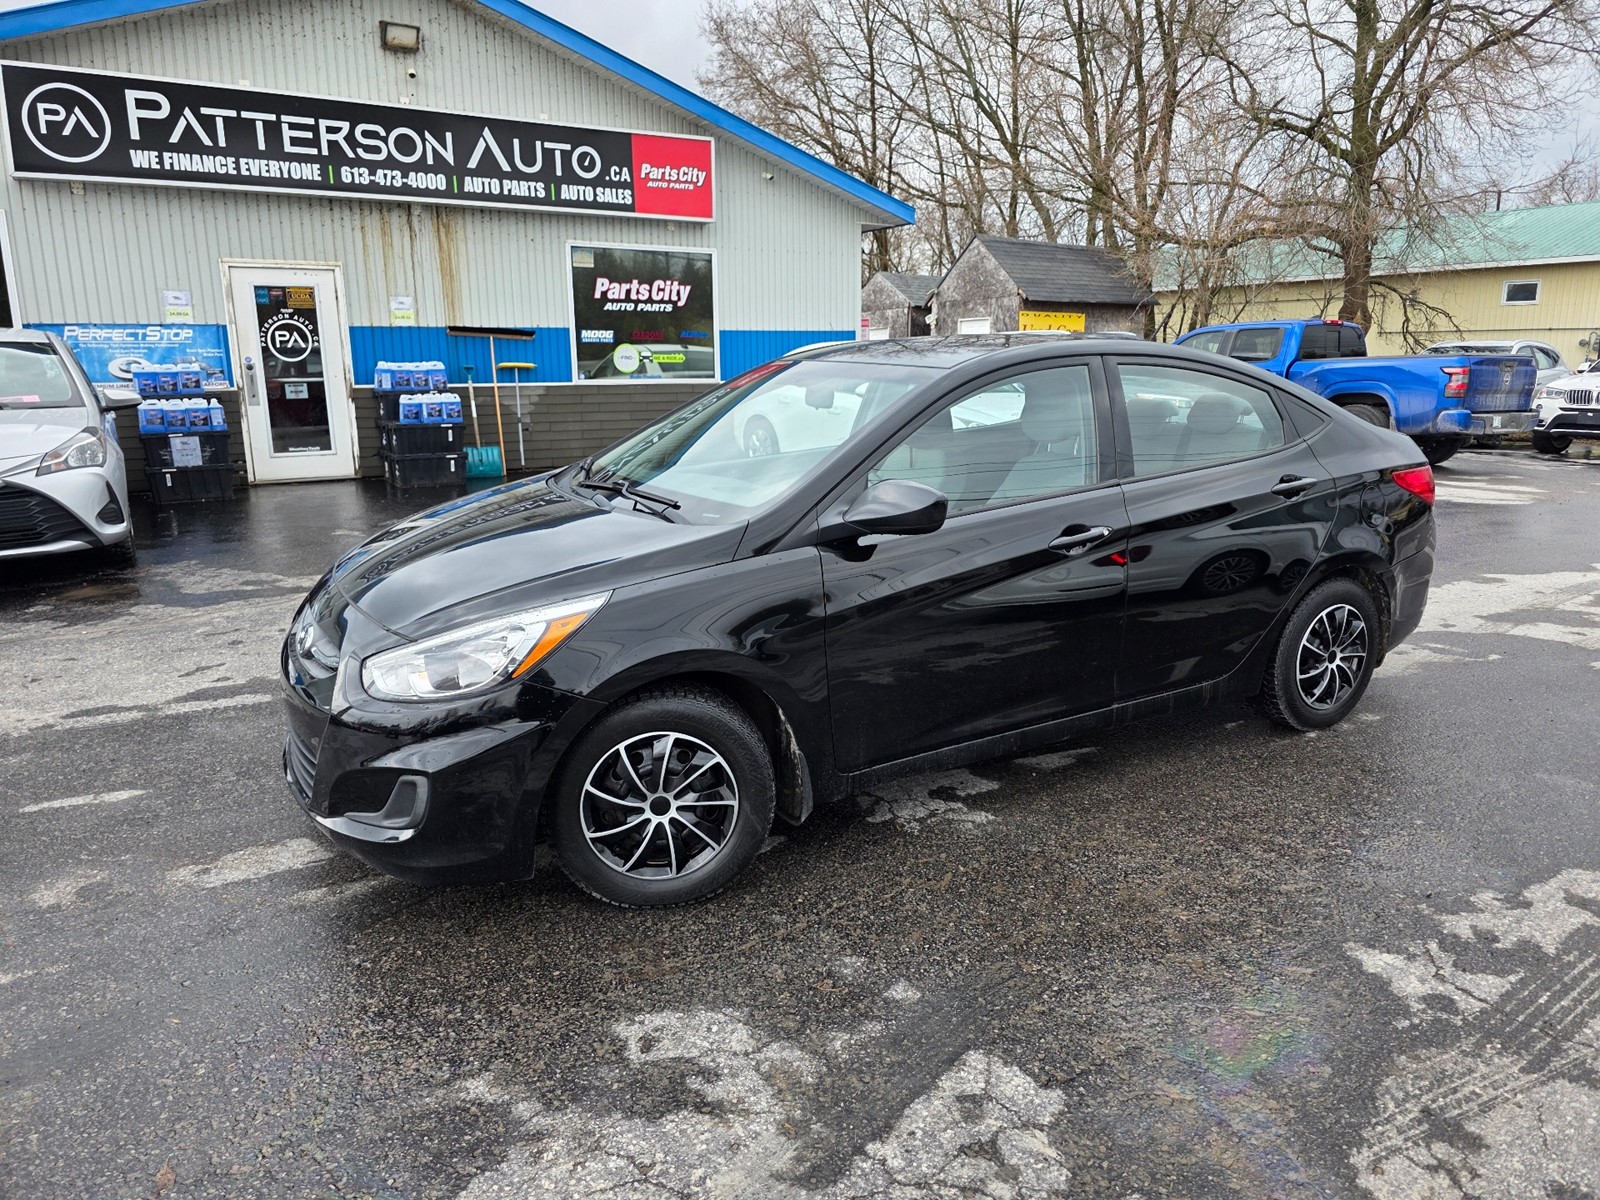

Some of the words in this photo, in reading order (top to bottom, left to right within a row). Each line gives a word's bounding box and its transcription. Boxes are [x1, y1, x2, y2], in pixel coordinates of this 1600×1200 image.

[124, 88, 455, 167] PATTERSON
[129, 149, 161, 169] WE
[163, 152, 237, 175] FINANCE
[239, 157, 322, 181] EVERYONE
[340, 165, 447, 190] 613-473-4000
[464, 176, 501, 195] AUTO
[503, 178, 546, 198] PARTS
[560, 184, 595, 202] AUTO
[596, 186, 633, 205] SALES
[646, 180, 668, 189] AUTO
[669, 181, 694, 190] PARTS
[603, 302, 635, 312] AUTO
[637, 303, 674, 313] PARTS
[260, 313, 290, 347] PATTERSON
[293, 314, 314, 331] AUTO
[581, 330, 614, 338] MOOG
[274, 330, 307, 348] PA
[620, 354, 633, 362] FIND
